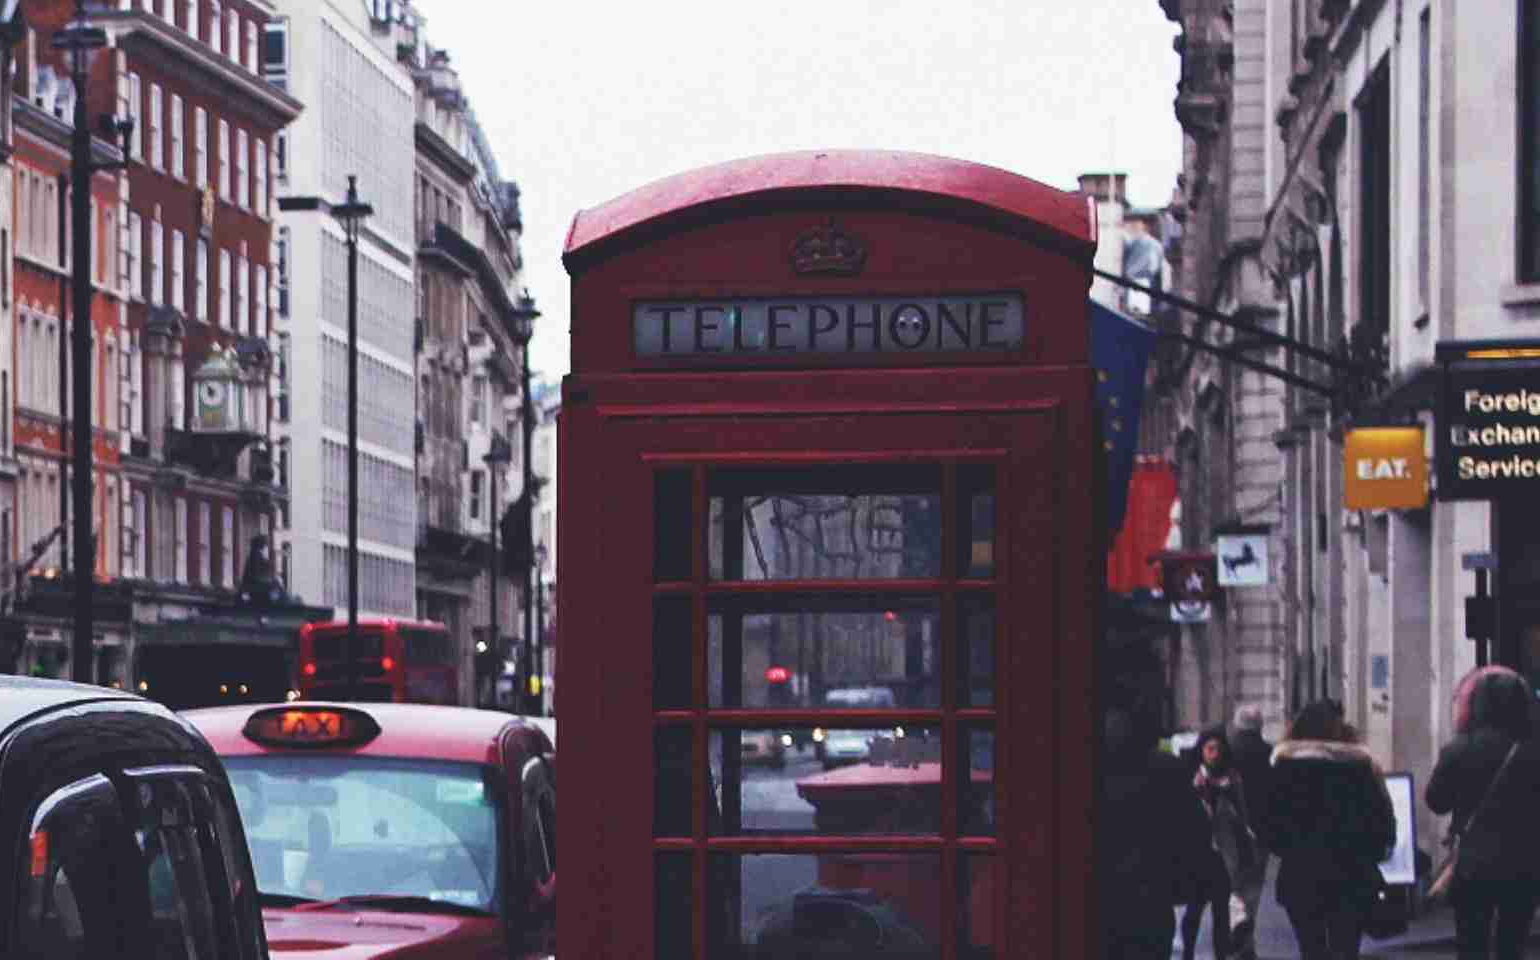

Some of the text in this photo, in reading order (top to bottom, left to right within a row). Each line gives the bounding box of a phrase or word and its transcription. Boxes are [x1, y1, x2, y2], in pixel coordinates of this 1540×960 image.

[647, 302, 1011, 353] TELEPHONE
[1356, 457, 1412, 480] EAT.
[272, 714, 345, 737] TAXI
